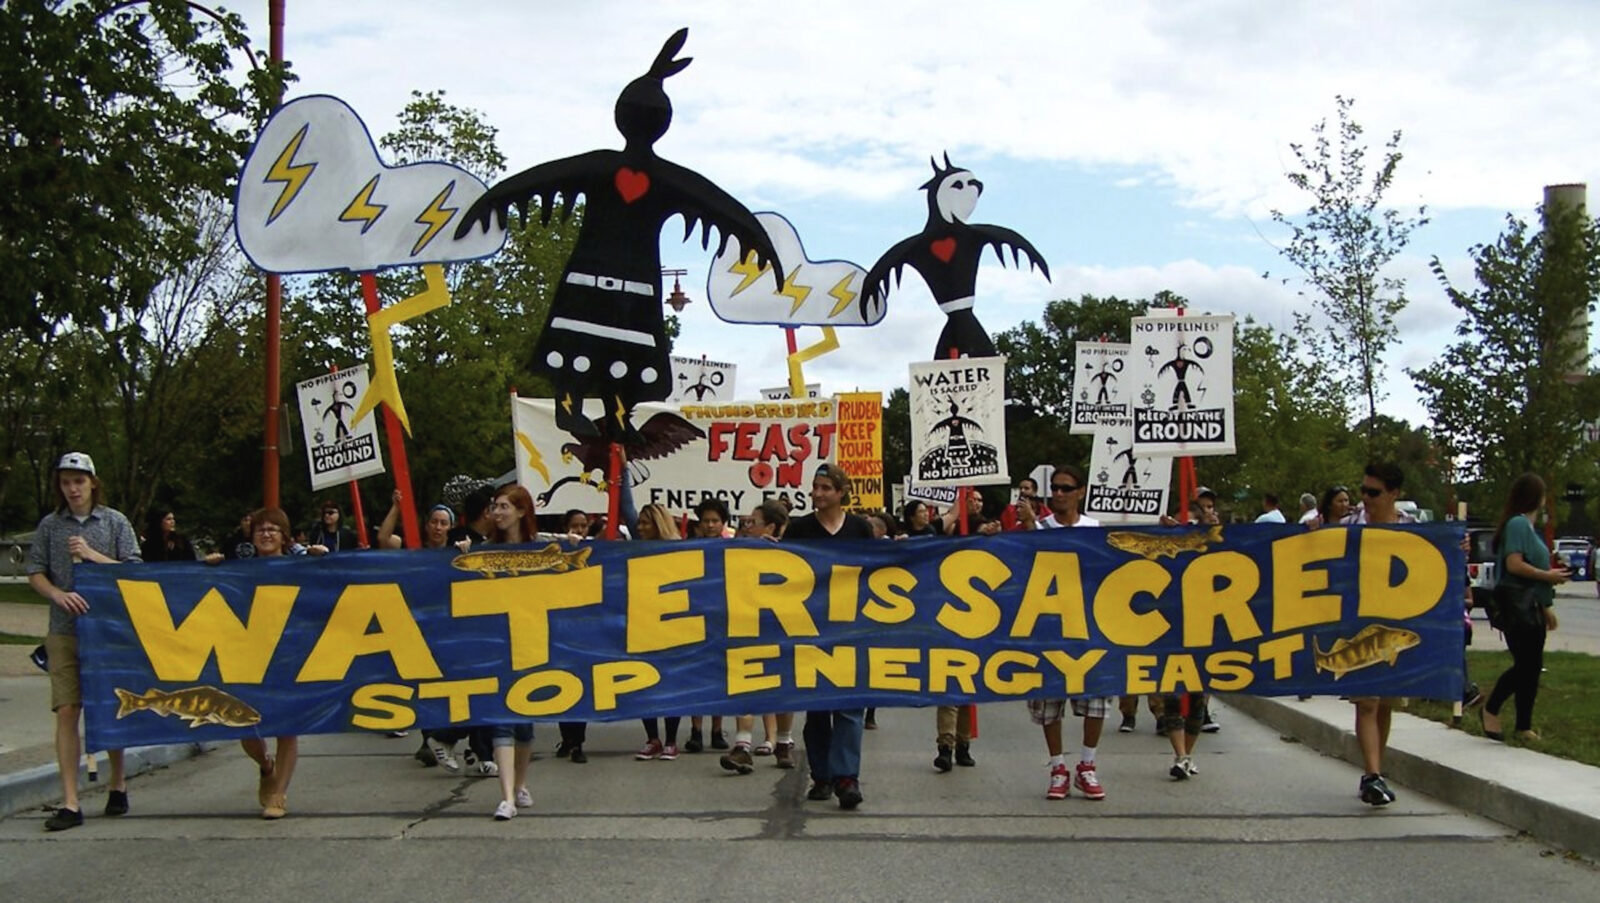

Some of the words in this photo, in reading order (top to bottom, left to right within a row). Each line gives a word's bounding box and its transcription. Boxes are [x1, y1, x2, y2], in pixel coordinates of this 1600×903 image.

[1136, 323, 1153, 332] NO
[1157, 323, 1219, 332] PIPELINES!
[675, 357, 687, 365] NO
[914, 367, 990, 387] WATER
[301, 380, 314, 390] NO
[930, 387, 938, 395] IS
[940, 383, 978, 395] SACRED
[768, 390, 817, 400] WAR
[680, 401, 833, 420] THUNDERBIRD
[1138, 410, 1168, 421] KEEP
[1198, 410, 1221, 421] THE
[1101, 418, 1117, 426] NO
[840, 422, 876, 441] KEEP
[1138, 422, 1222, 440] GROUND
[355, 435, 372, 447] THE
[708, 422, 837, 463] FEAST
[839, 442, 873, 458] YOUR
[316, 445, 373, 472] GROUND
[748, 461, 803, 489] ON
[922, 469, 940, 479] NO
[942, 464, 997, 477] PIPELINES!
[848, 478, 881, 495] ATION
[1092, 487, 1115, 497] KEEP
[1140, 490, 1159, 499] THE
[852, 496, 862, 506] 2
[910, 486, 956, 503] GROUND
[1090, 497, 1159, 512] GROUND
[116, 547, 820, 684] WATER
[827, 564, 919, 624] IS
[935, 527, 1448, 647] SACRED
[351, 660, 661, 731] STOP
[726, 644, 1108, 696] ENERGY
[1126, 633, 1304, 694] EAST
